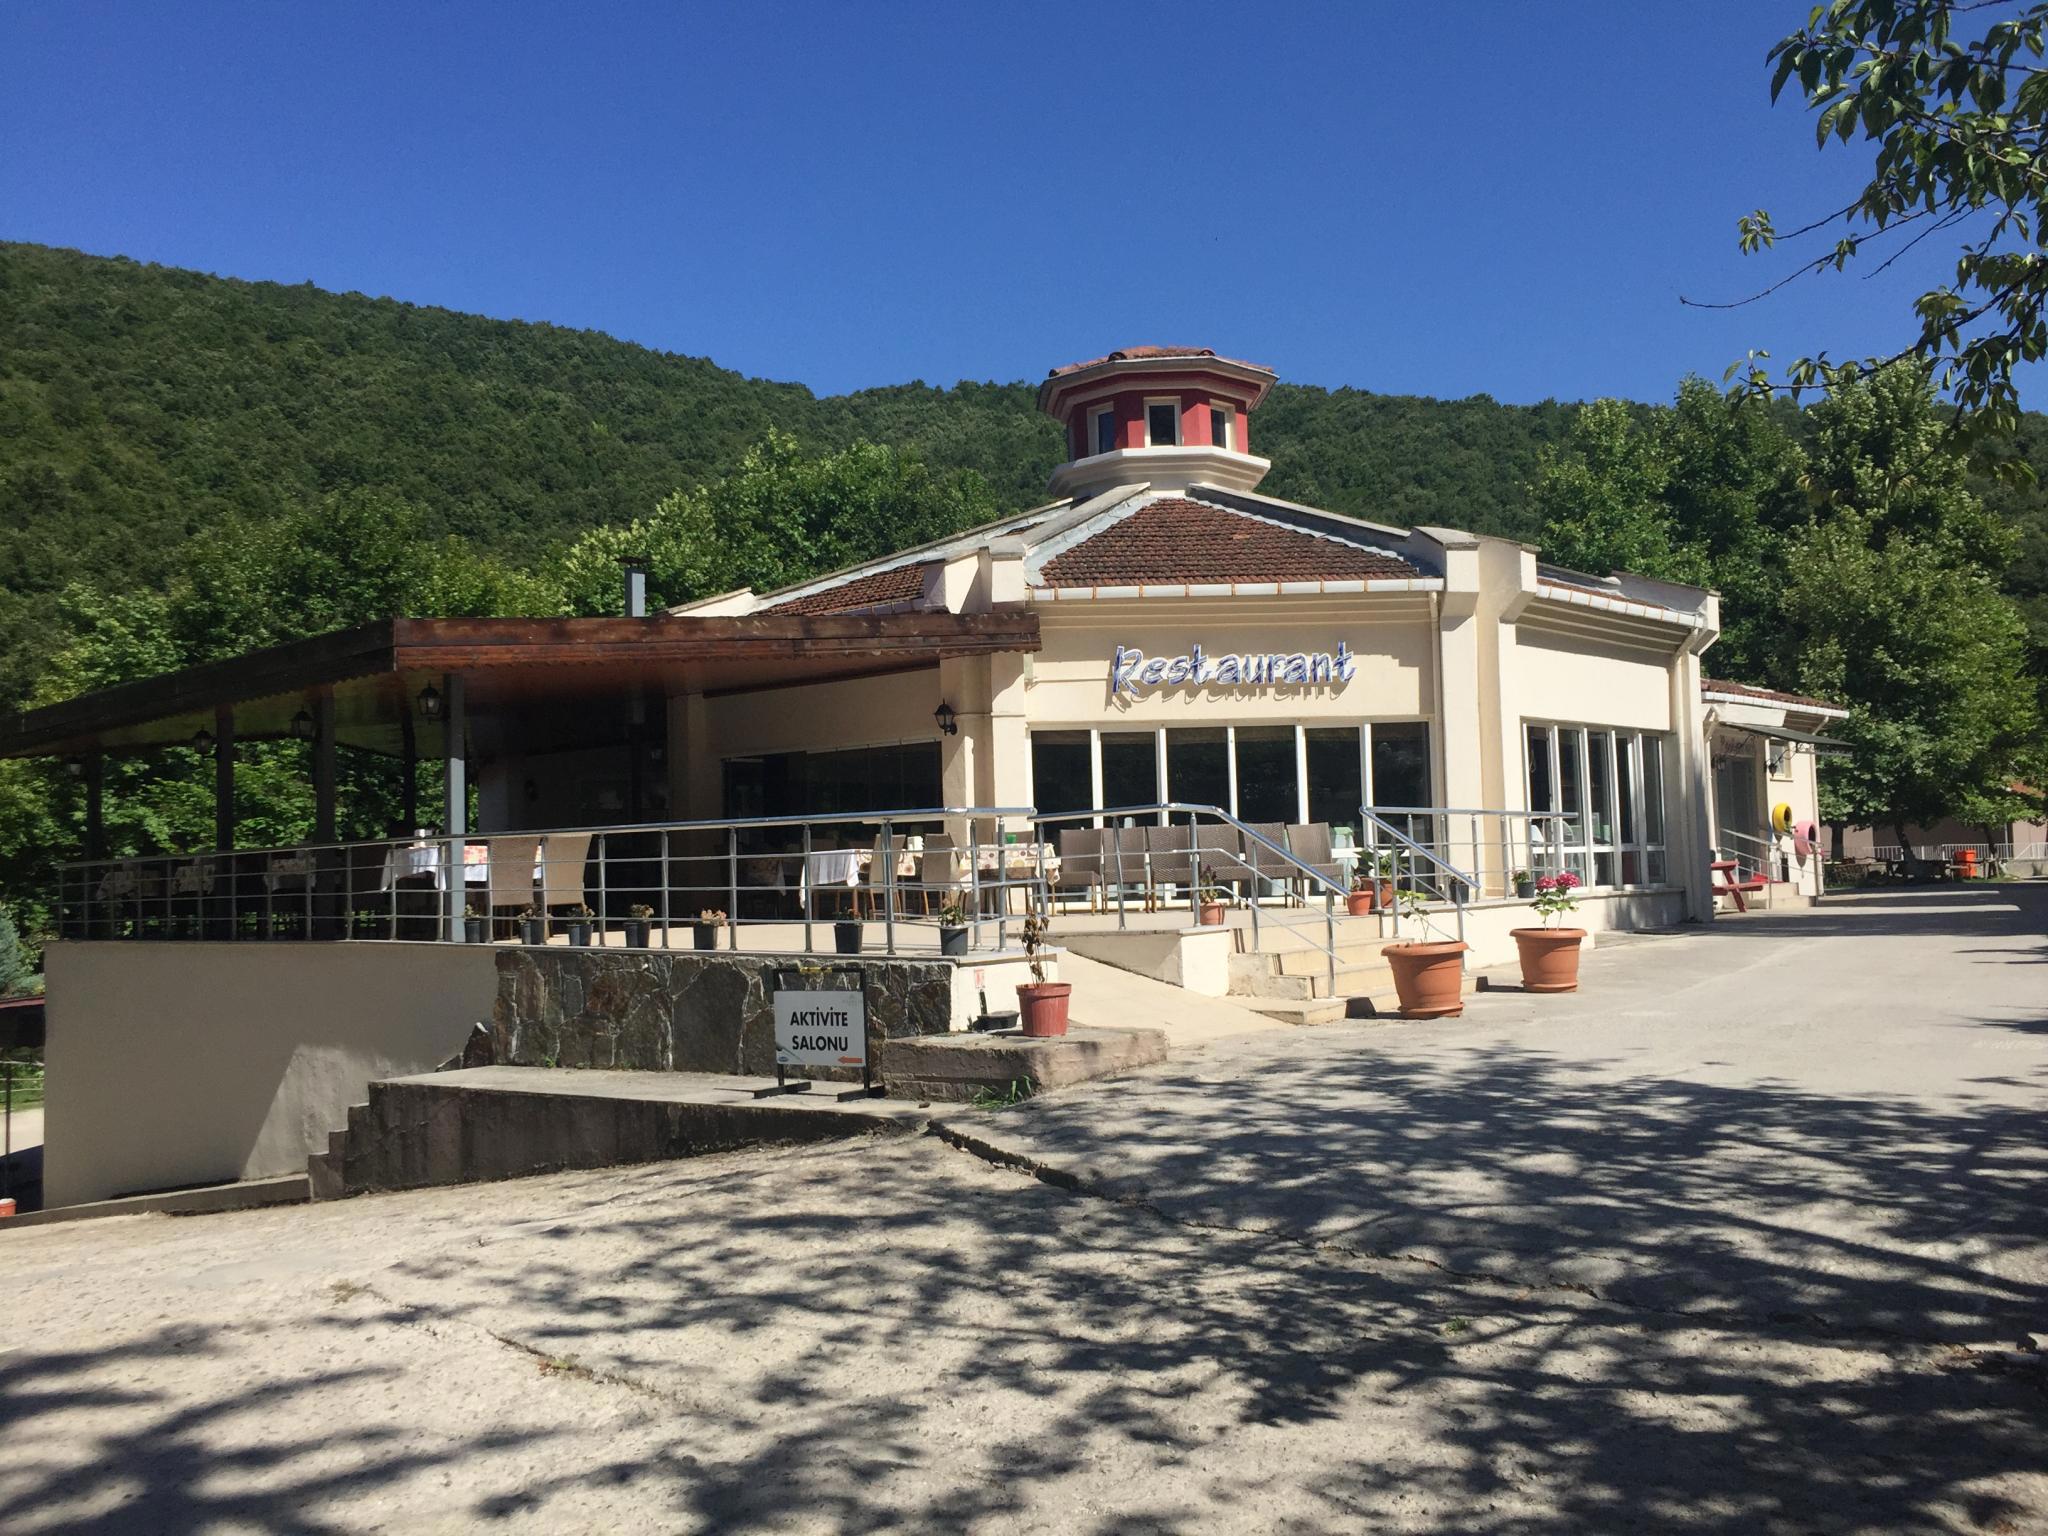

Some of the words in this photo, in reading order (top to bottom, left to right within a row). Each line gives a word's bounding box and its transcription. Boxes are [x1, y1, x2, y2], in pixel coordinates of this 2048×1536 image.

[1112, 640, 1357, 695] Restaurant
[790, 1007, 848, 1027] AKTİVİTE
[792, 1035, 848, 1051] SALONU
